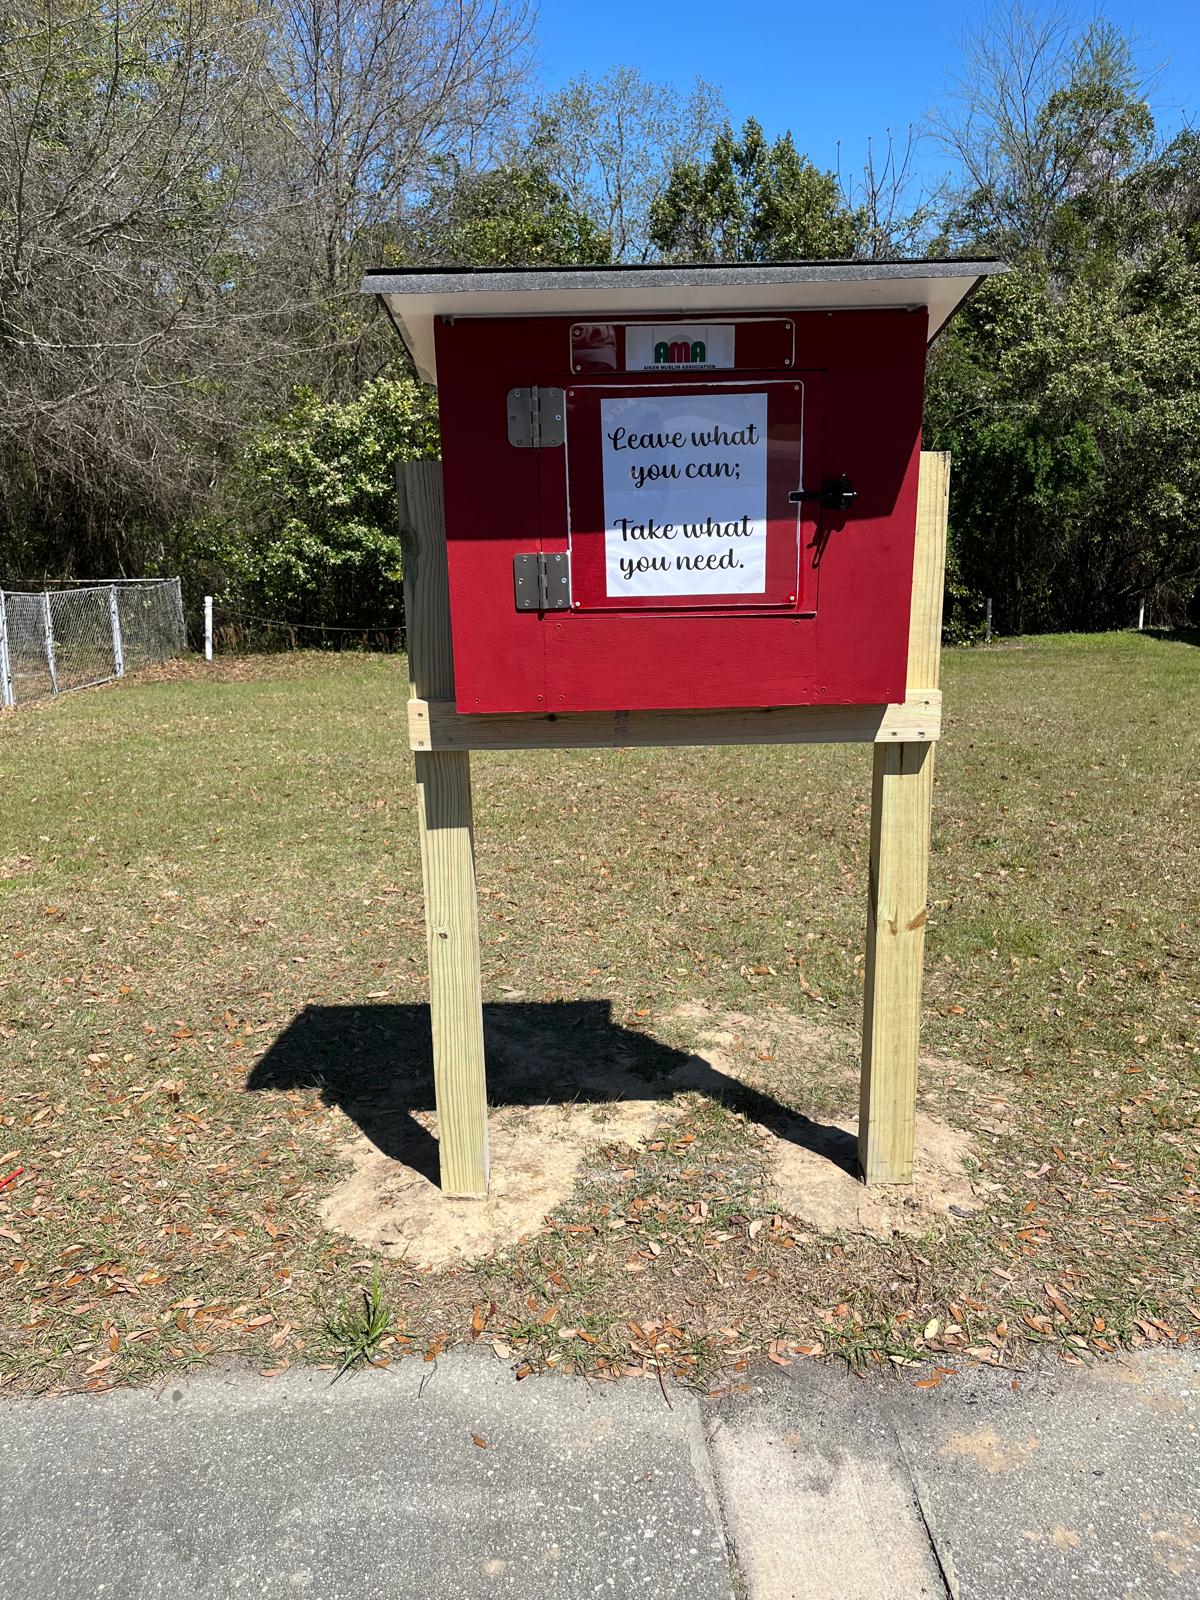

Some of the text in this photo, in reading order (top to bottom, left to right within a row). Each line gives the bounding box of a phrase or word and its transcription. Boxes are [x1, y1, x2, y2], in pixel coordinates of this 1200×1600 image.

[654, 341, 706, 363] AMA
[607, 423, 760, 451] Leave what
[631, 460, 741, 489] you can;
[613, 514, 754, 542] Take what
[619, 548, 745, 581] you need.
